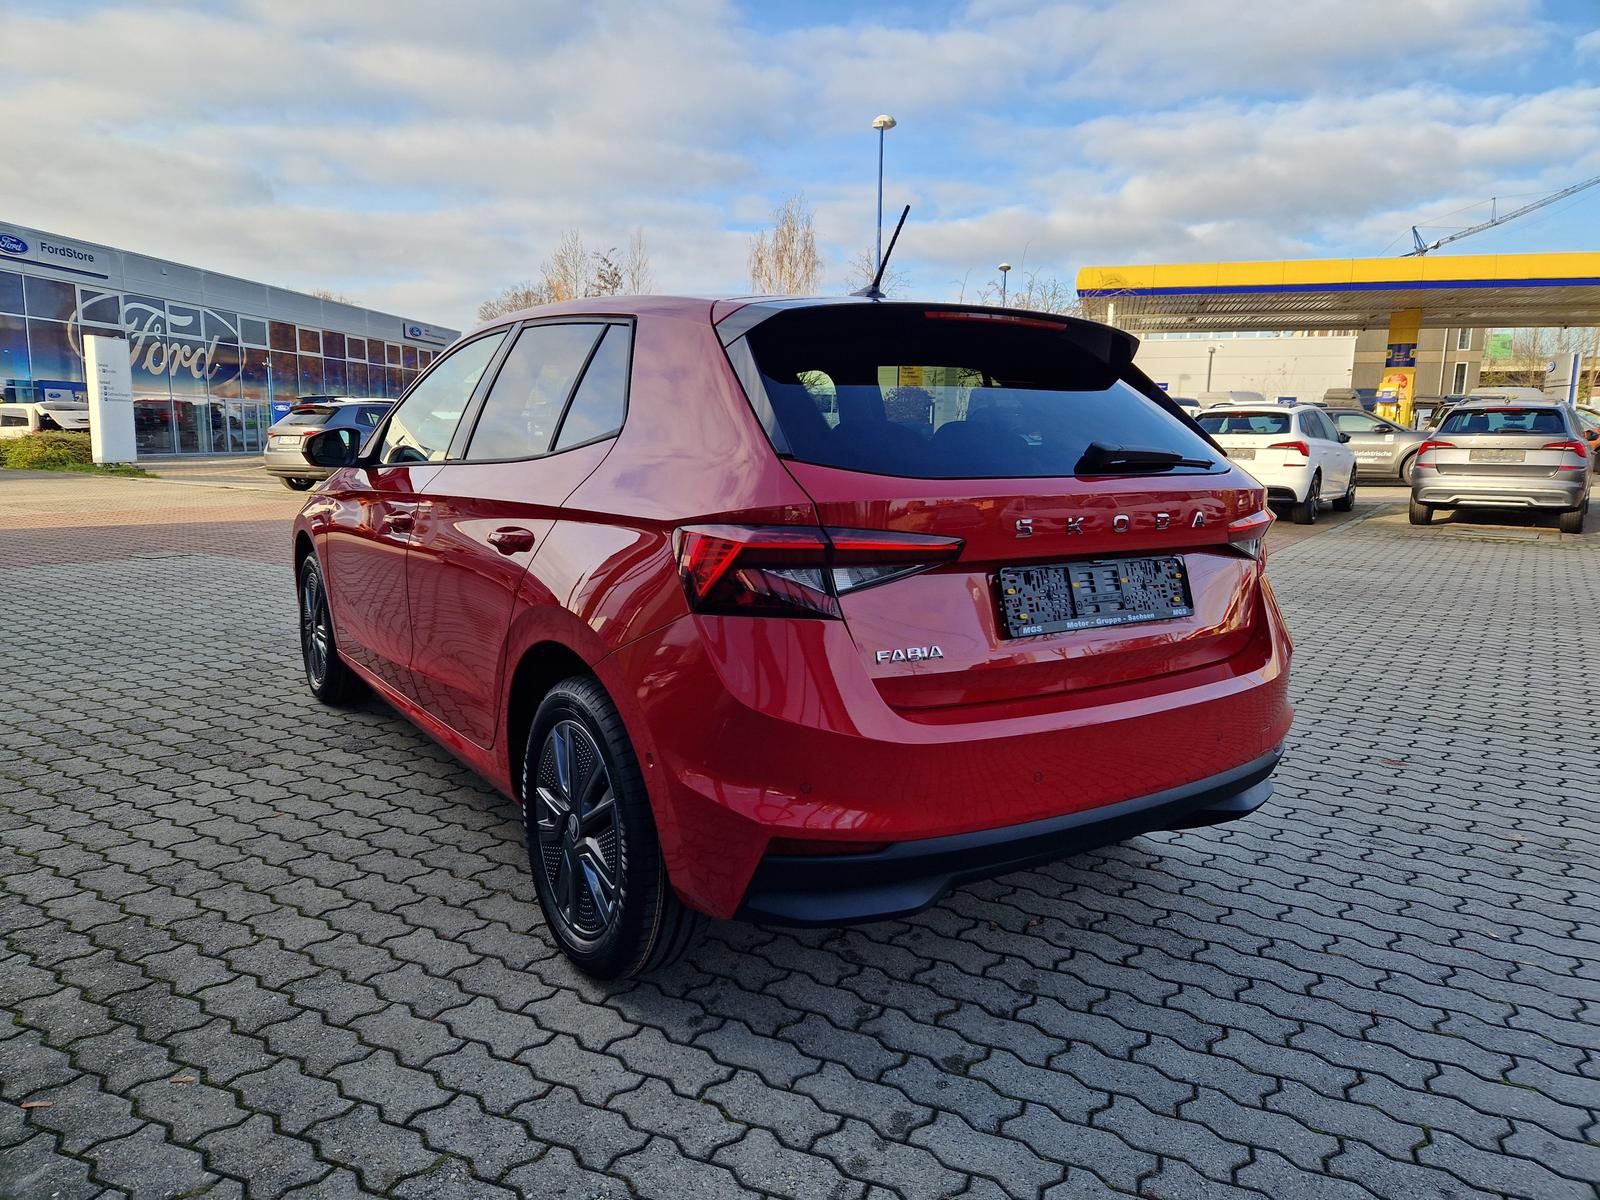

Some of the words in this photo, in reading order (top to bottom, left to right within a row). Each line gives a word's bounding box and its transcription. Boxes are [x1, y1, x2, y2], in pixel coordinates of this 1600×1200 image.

[0, 236, 23, 251] Ford
[40, 241, 95, 263] FordStore
[123, 302, 221, 379] Ford
[1022, 625, 1043, 634] MGS
[1066, 621, 1089, 629] Motor
[1096, 617, 1122, 625] Gruppe
[1127, 613, 1155, 621] Sachsen
[875, 645, 944, 665] FABIA
